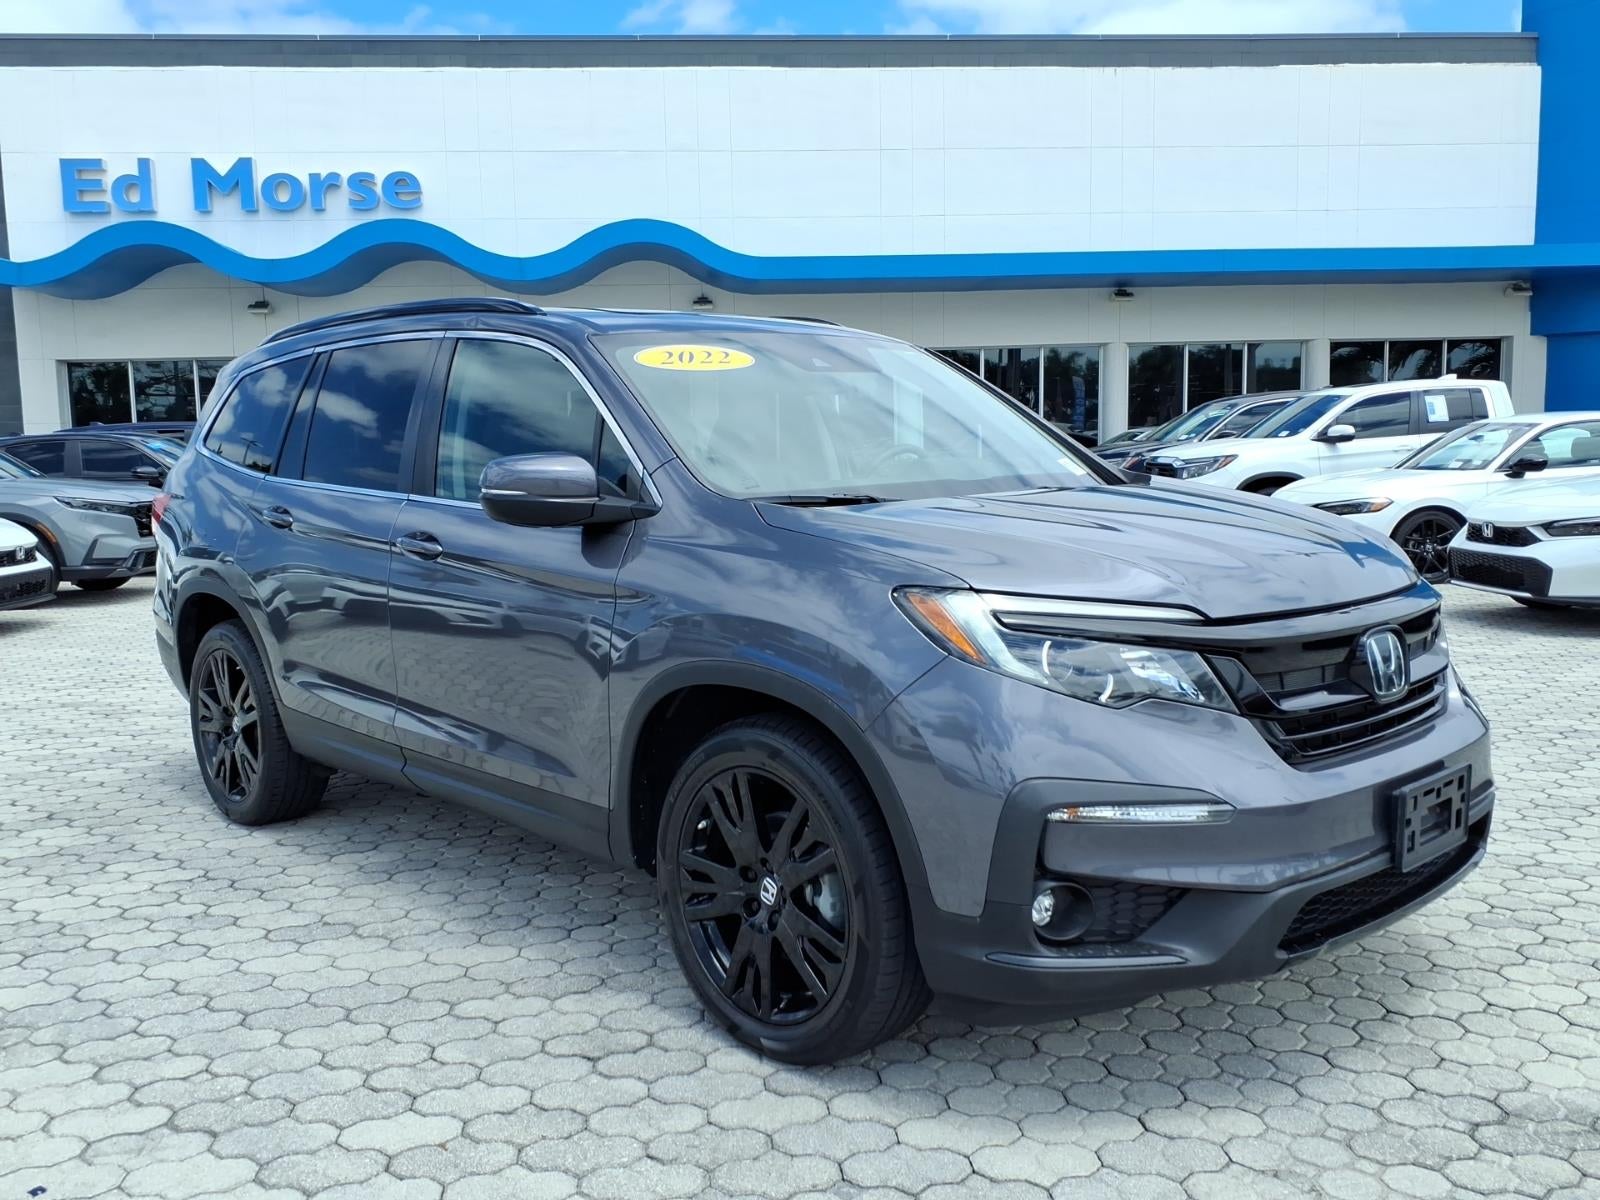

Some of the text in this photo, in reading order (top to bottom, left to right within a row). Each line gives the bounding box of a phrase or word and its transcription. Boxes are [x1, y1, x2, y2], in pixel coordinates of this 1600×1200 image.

[59, 157, 422, 213] Ed Morse
[662, 351, 730, 364] 2022
